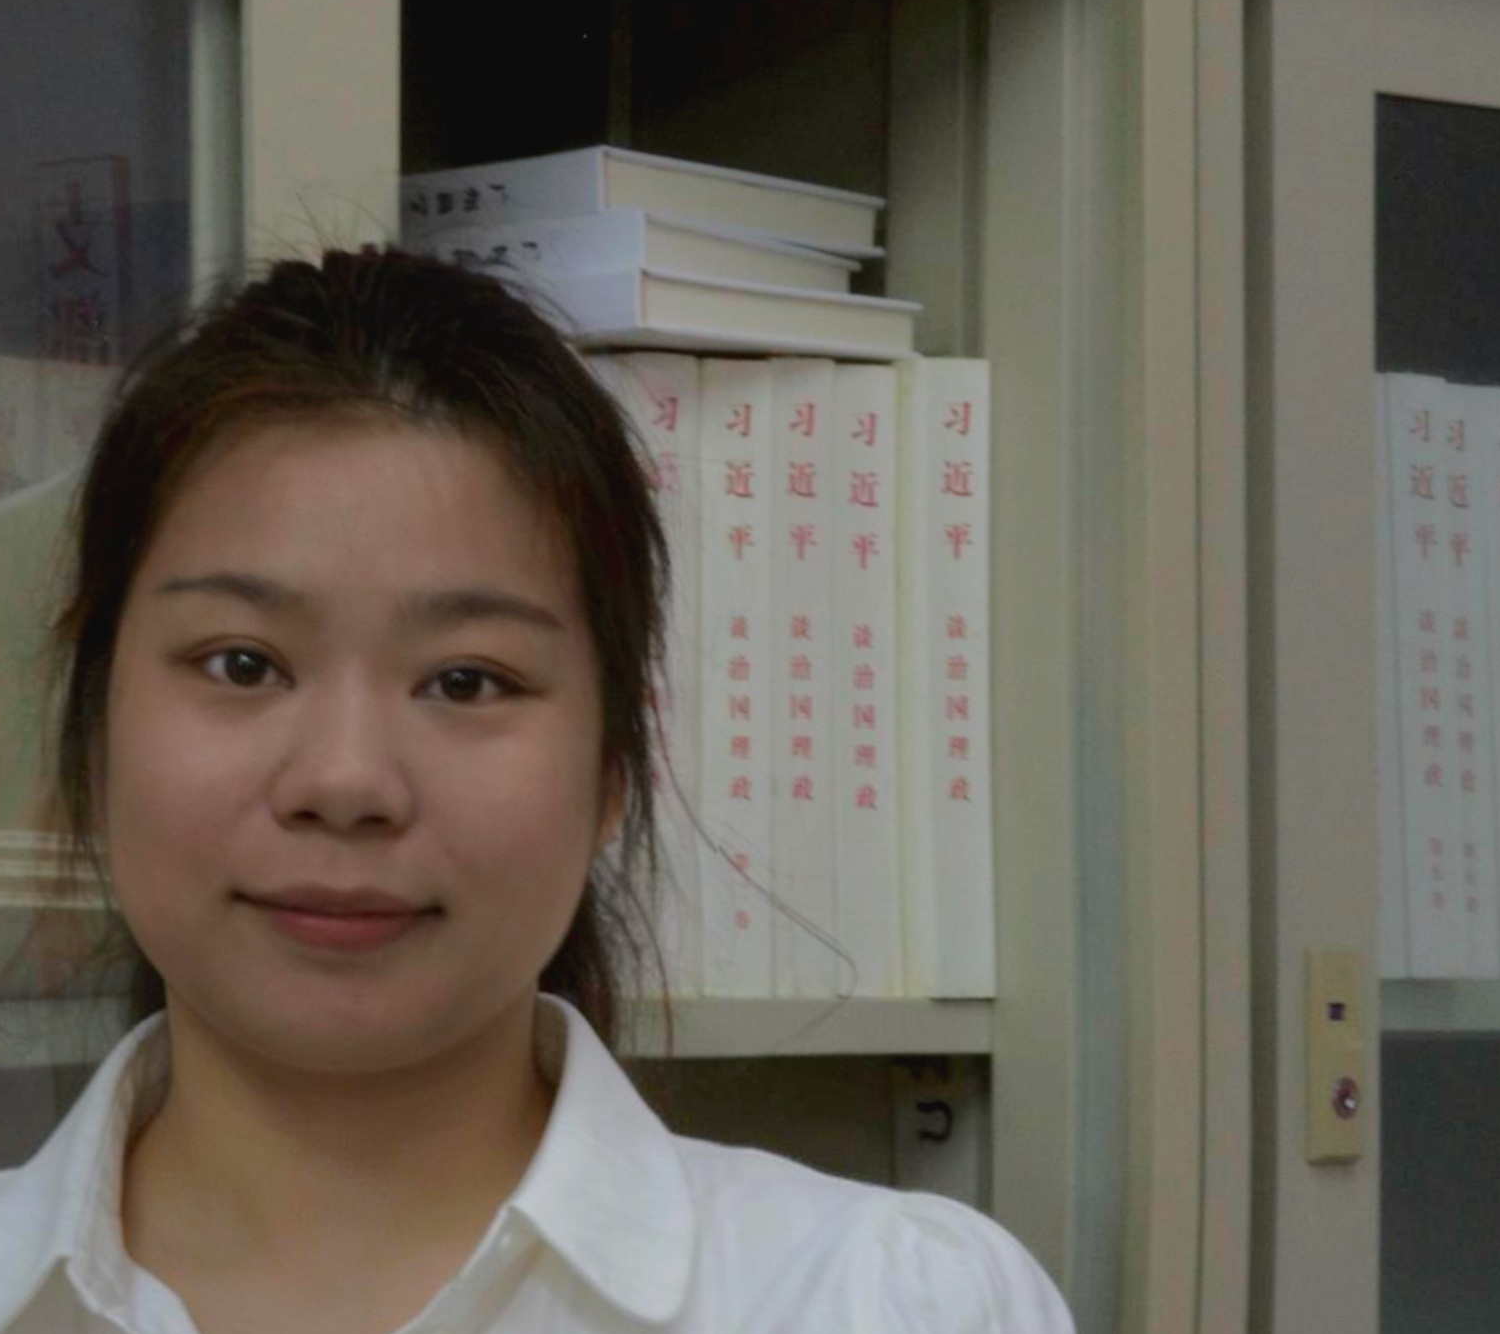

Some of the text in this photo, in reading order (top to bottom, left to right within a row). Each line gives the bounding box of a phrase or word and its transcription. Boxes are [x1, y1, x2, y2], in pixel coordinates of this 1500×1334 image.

[724, 401, 755, 560] 习近平
[787, 401, 818, 802] 习近平 谈治国理政
[847, 411, 880, 810] 习近平 谈治国理政
[941, 400, 974, 802] 习近平 谈治国理政
[728, 616, 752, 801] 谈治国理政
